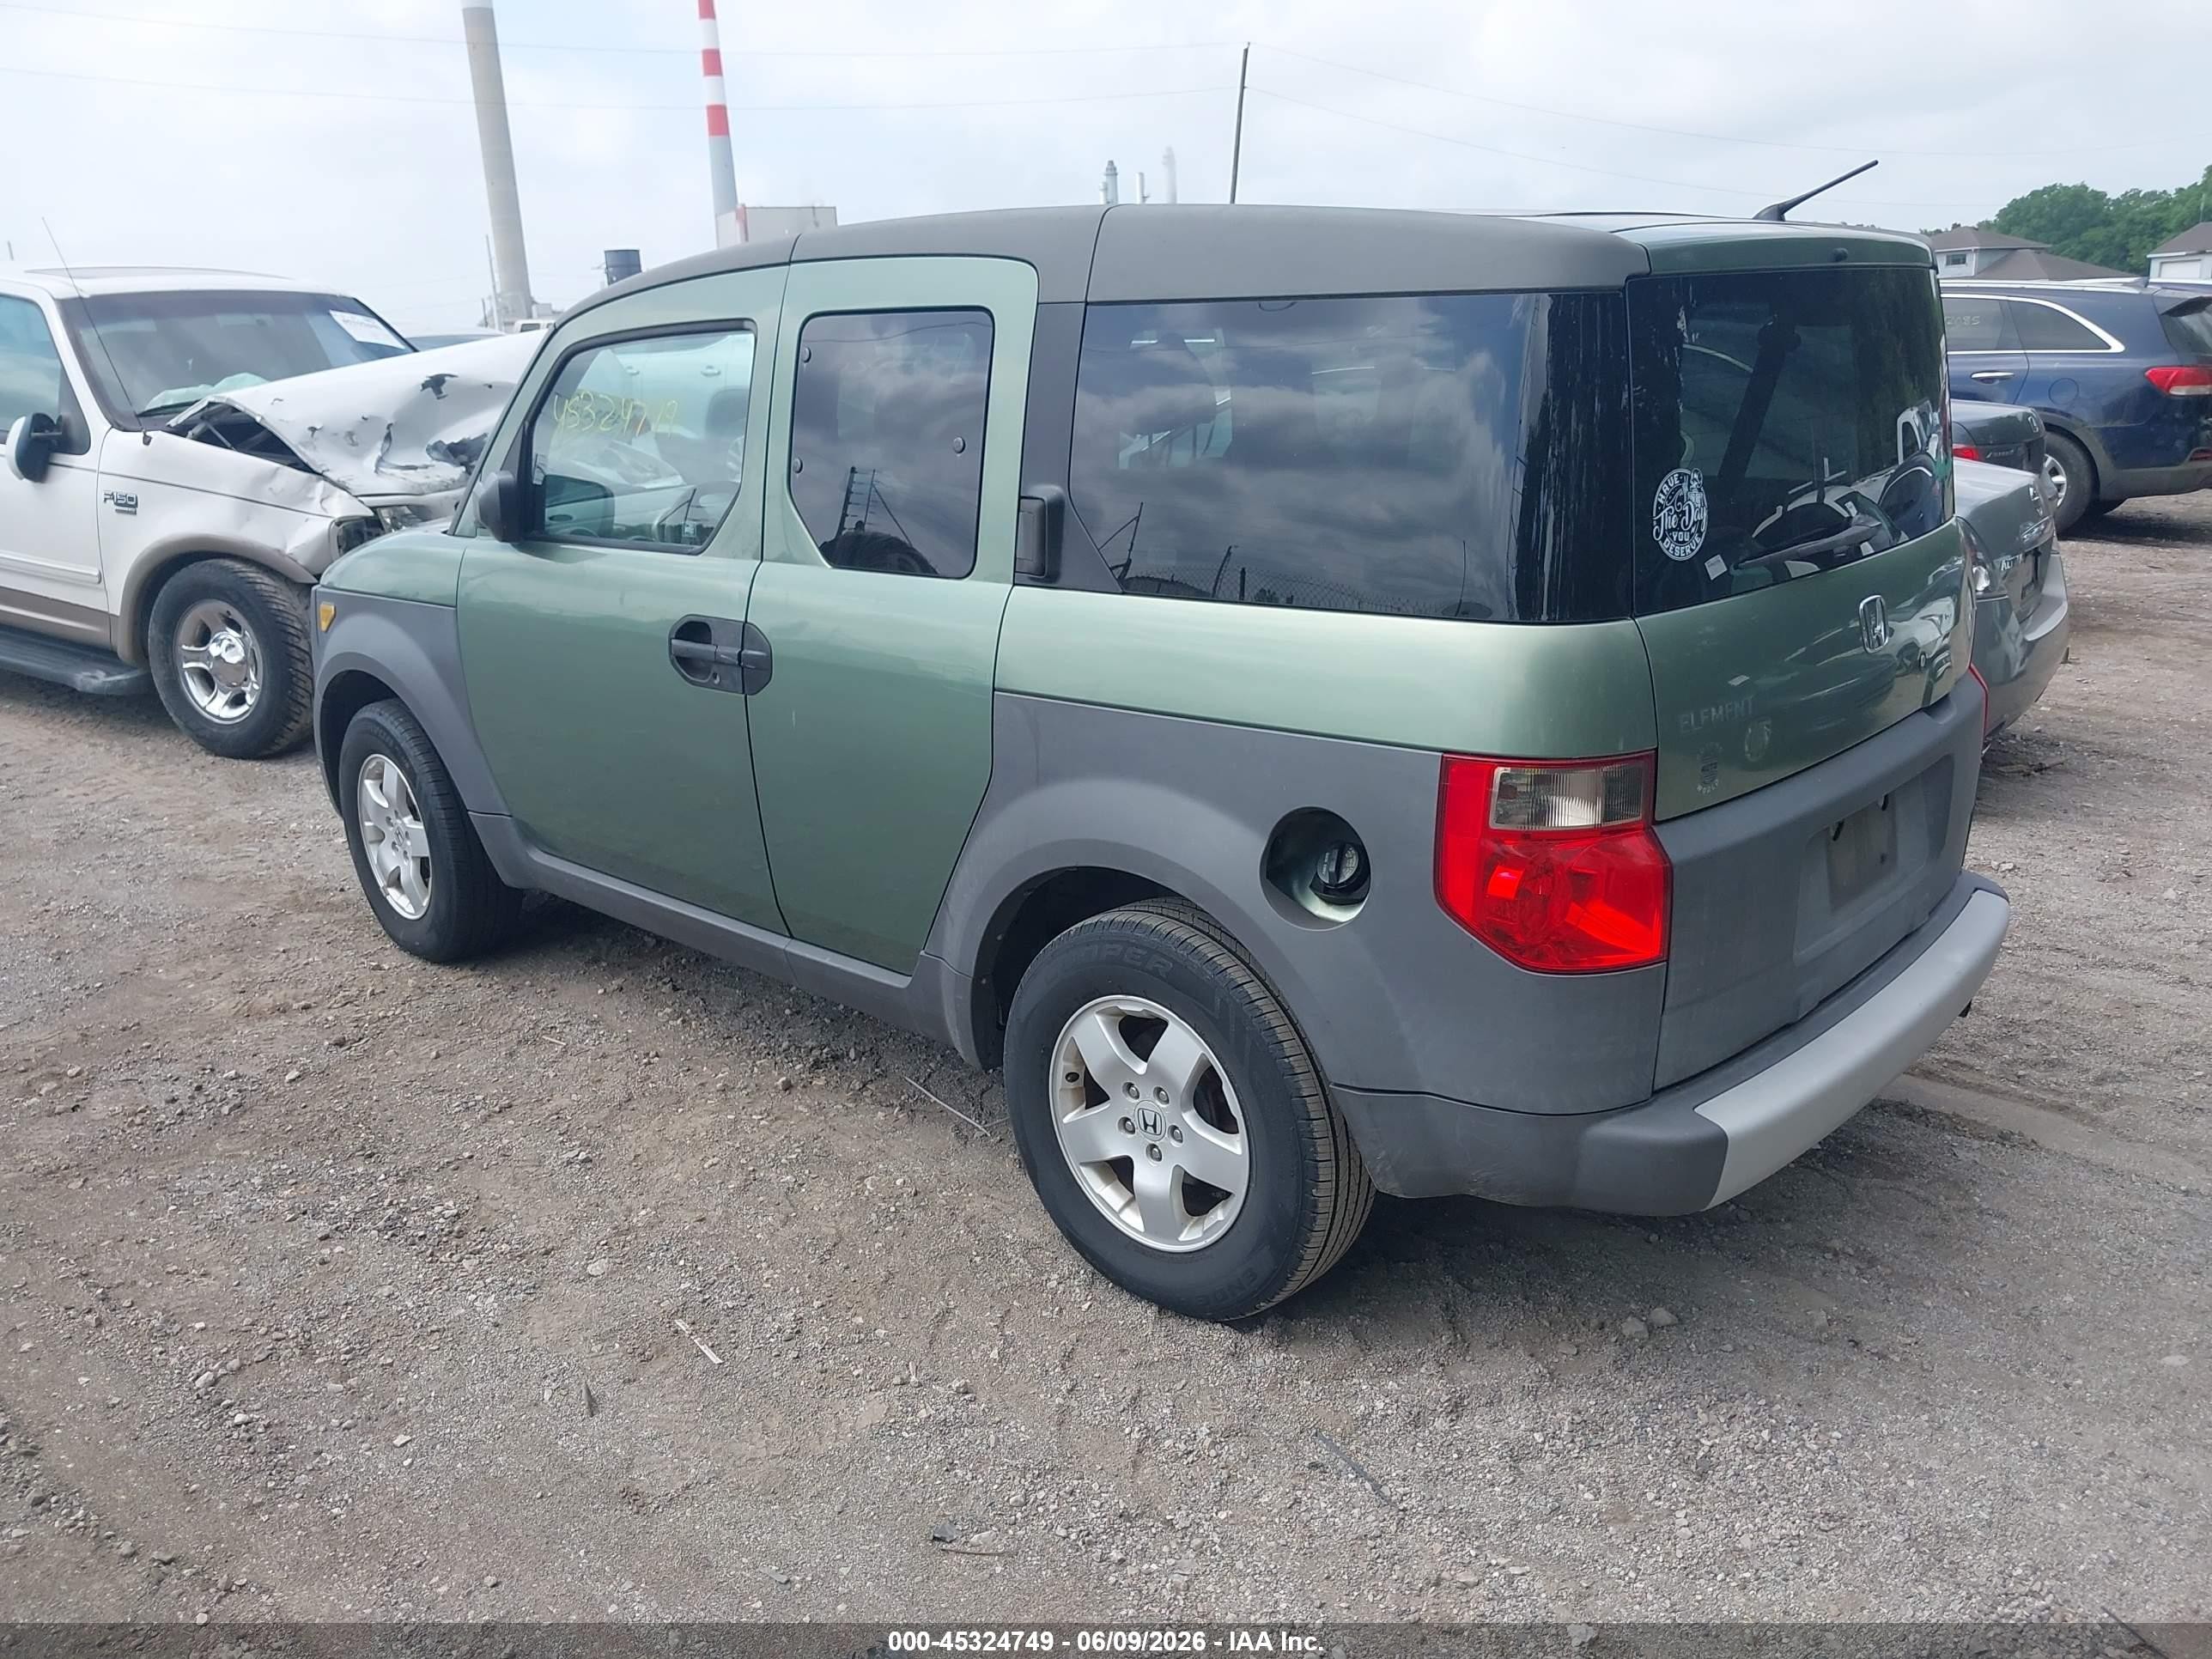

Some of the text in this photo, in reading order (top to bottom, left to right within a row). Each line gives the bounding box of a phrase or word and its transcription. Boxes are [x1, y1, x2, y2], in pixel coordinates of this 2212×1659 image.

[1657, 473, 1680, 505] HAVE
[1653, 501, 1706, 541] The Day
[1663, 532, 1701, 557] DESERVE
[1672, 531, 1690, 542] YOU
